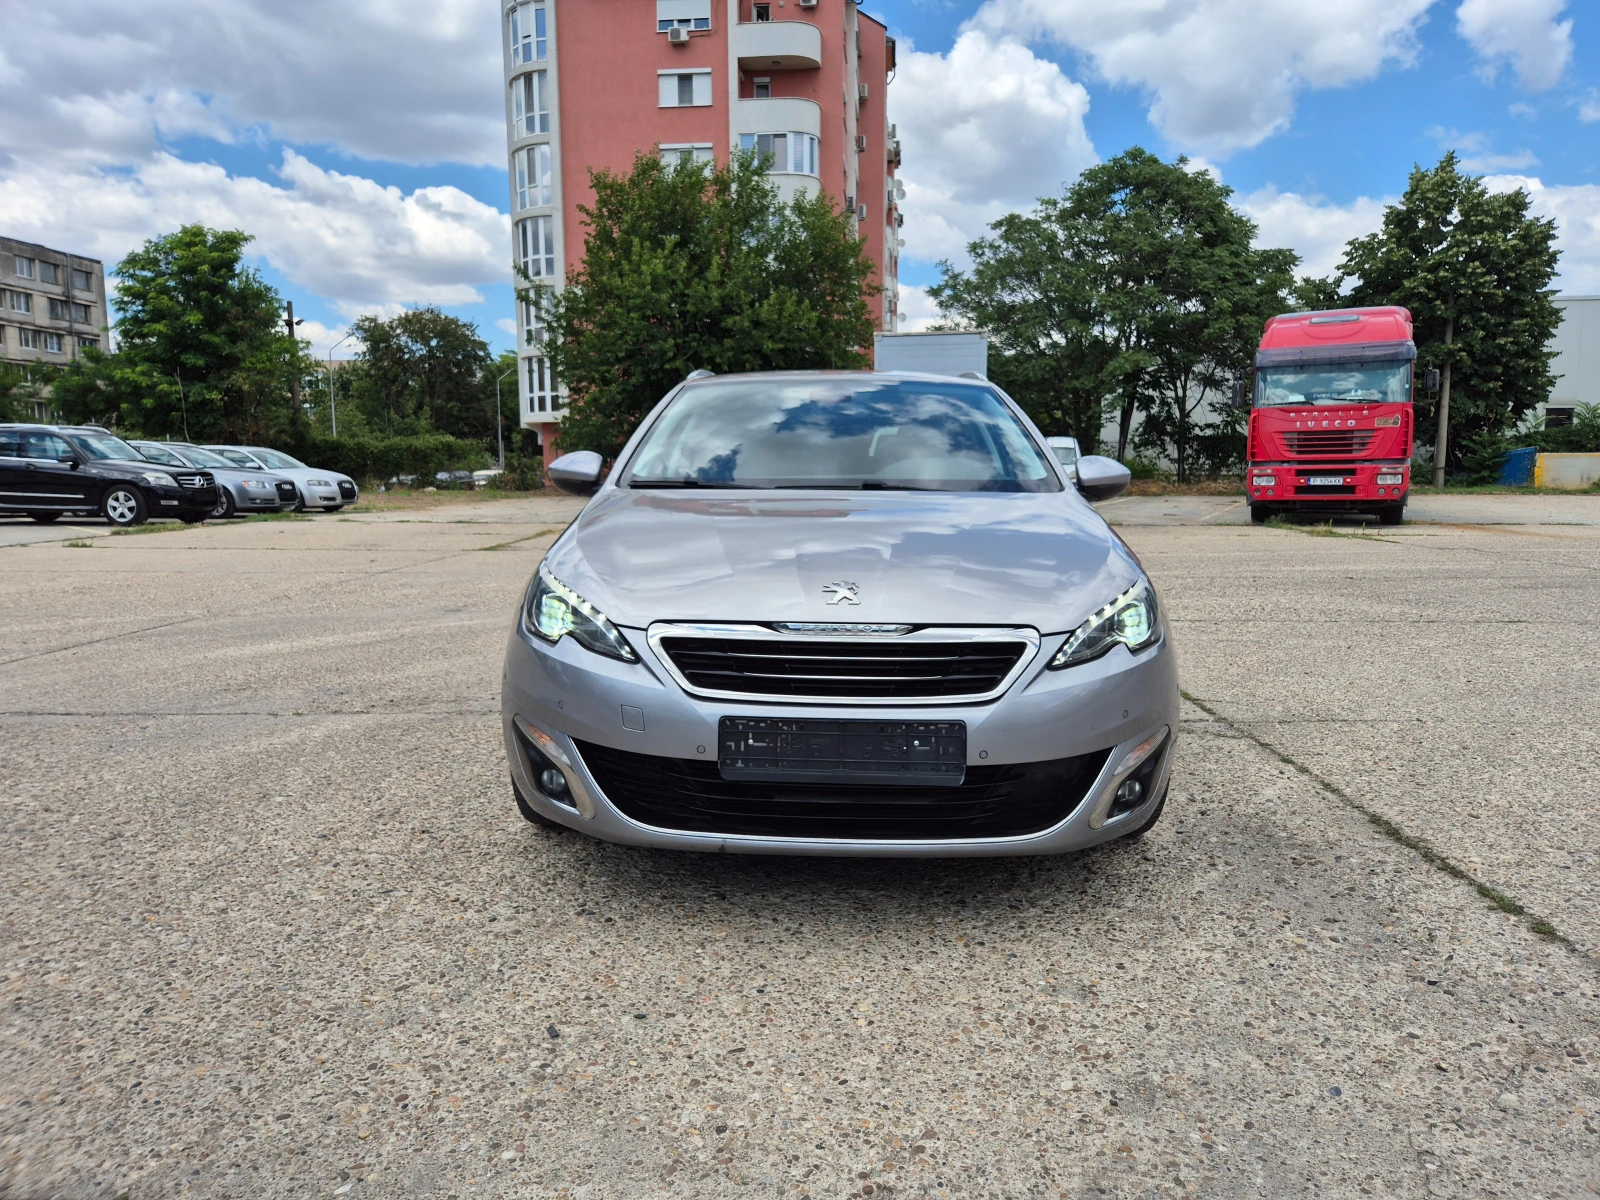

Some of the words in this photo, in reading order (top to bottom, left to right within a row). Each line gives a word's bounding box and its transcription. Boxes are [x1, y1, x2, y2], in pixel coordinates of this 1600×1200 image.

[1289, 410, 1369, 418] STRALIS
[1296, 420, 1356, 428] IVECO
[801, 624, 884, 633] PEUGEOT
